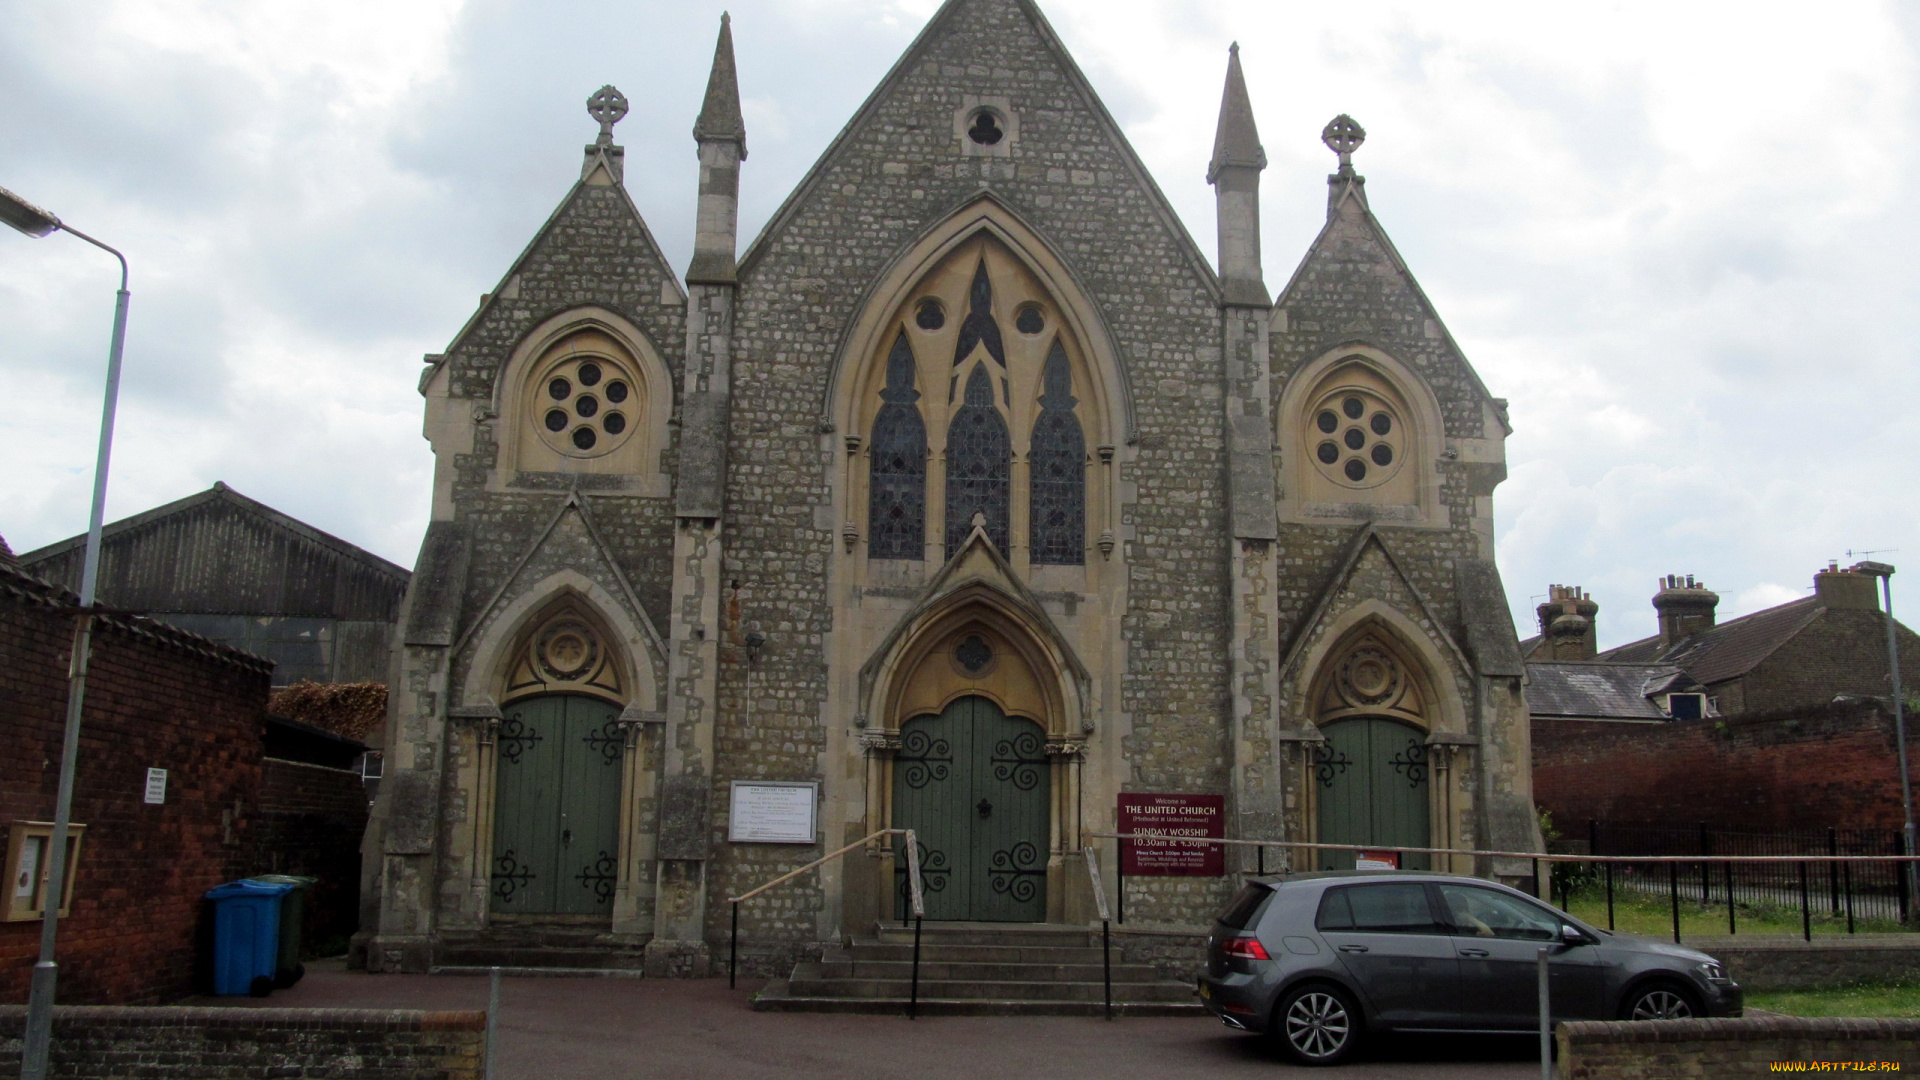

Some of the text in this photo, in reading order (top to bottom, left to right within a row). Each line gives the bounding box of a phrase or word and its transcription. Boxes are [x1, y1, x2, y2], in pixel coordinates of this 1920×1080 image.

[1125, 805, 1216, 815] THE UNITED CHURCH
[1133, 827, 1208, 837] SUNDAY WORSHIP
[1133, 838, 1167, 847] 10.30am
[1169, 839, 1177, 847] &
